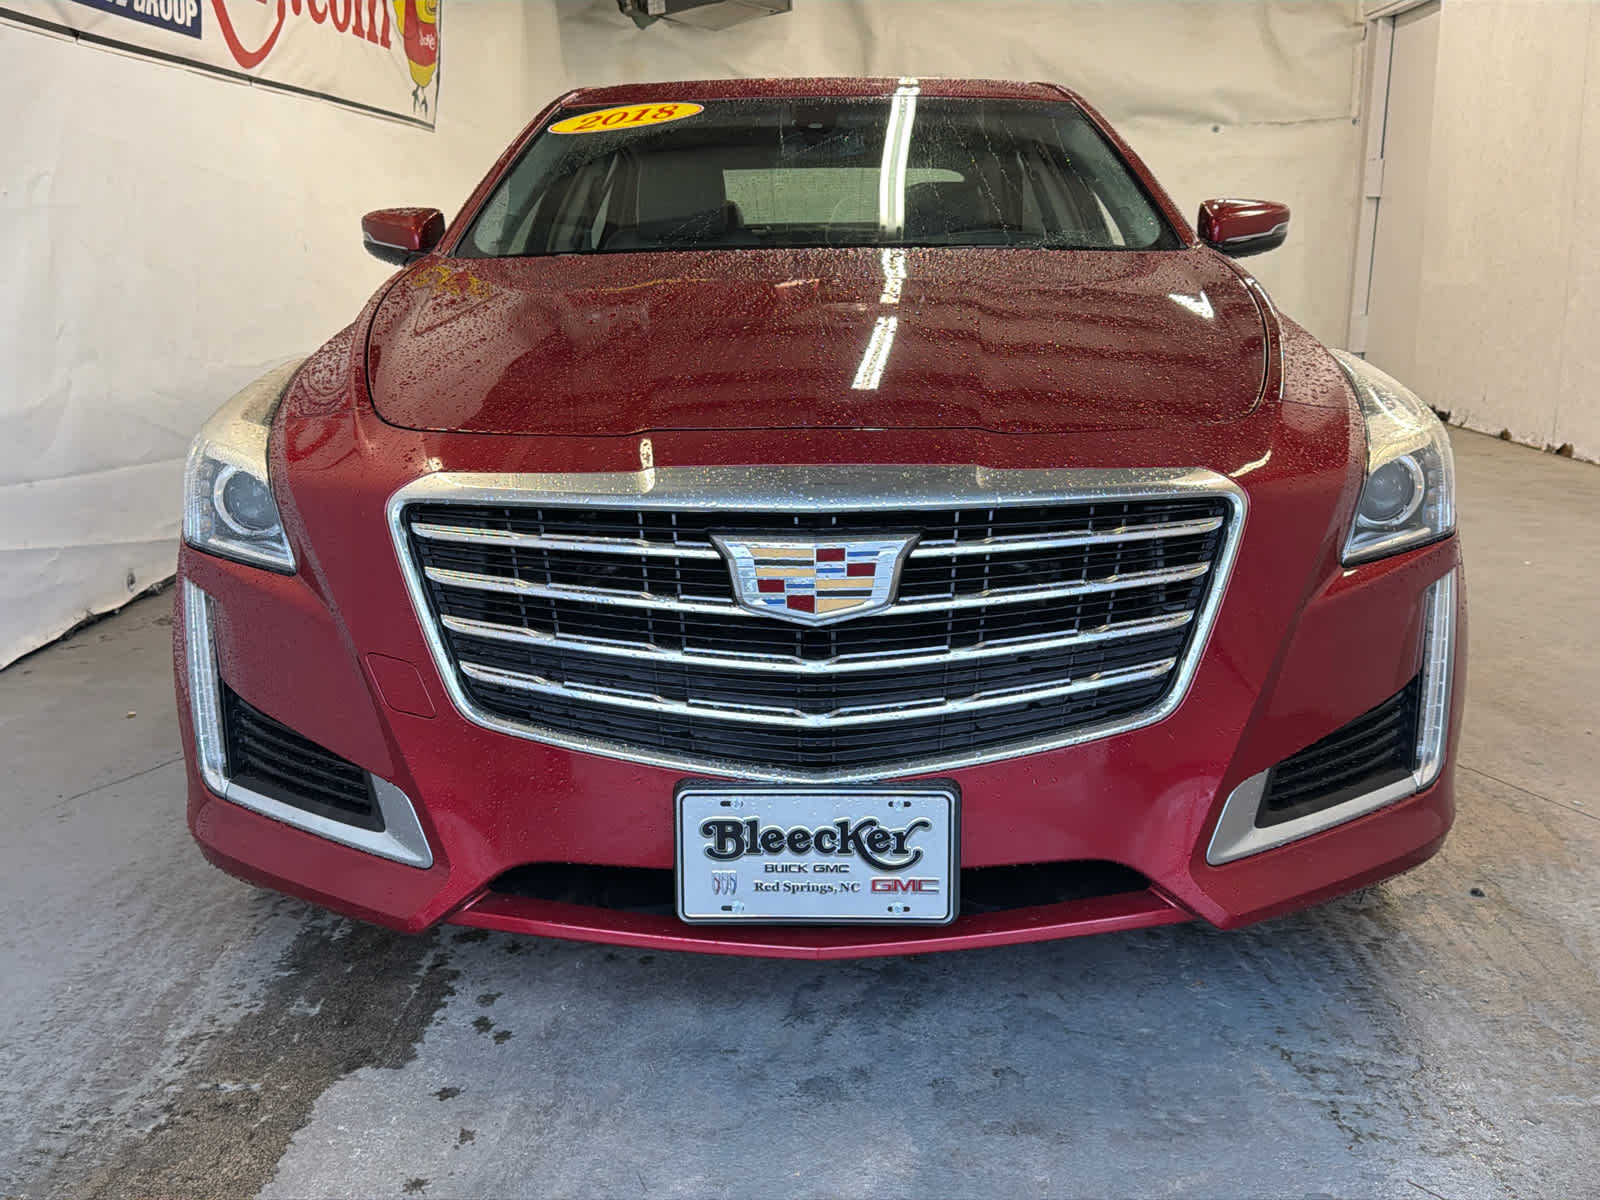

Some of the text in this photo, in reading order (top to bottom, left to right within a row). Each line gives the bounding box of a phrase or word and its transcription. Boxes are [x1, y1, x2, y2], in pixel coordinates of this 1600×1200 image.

[573, 105, 679, 131] 2018
[764, 863, 850, 873] BUICK GMC
[753, 880, 781, 893] Red
[839, 882, 861, 893] NC
[871, 878, 940, 894] GMC
